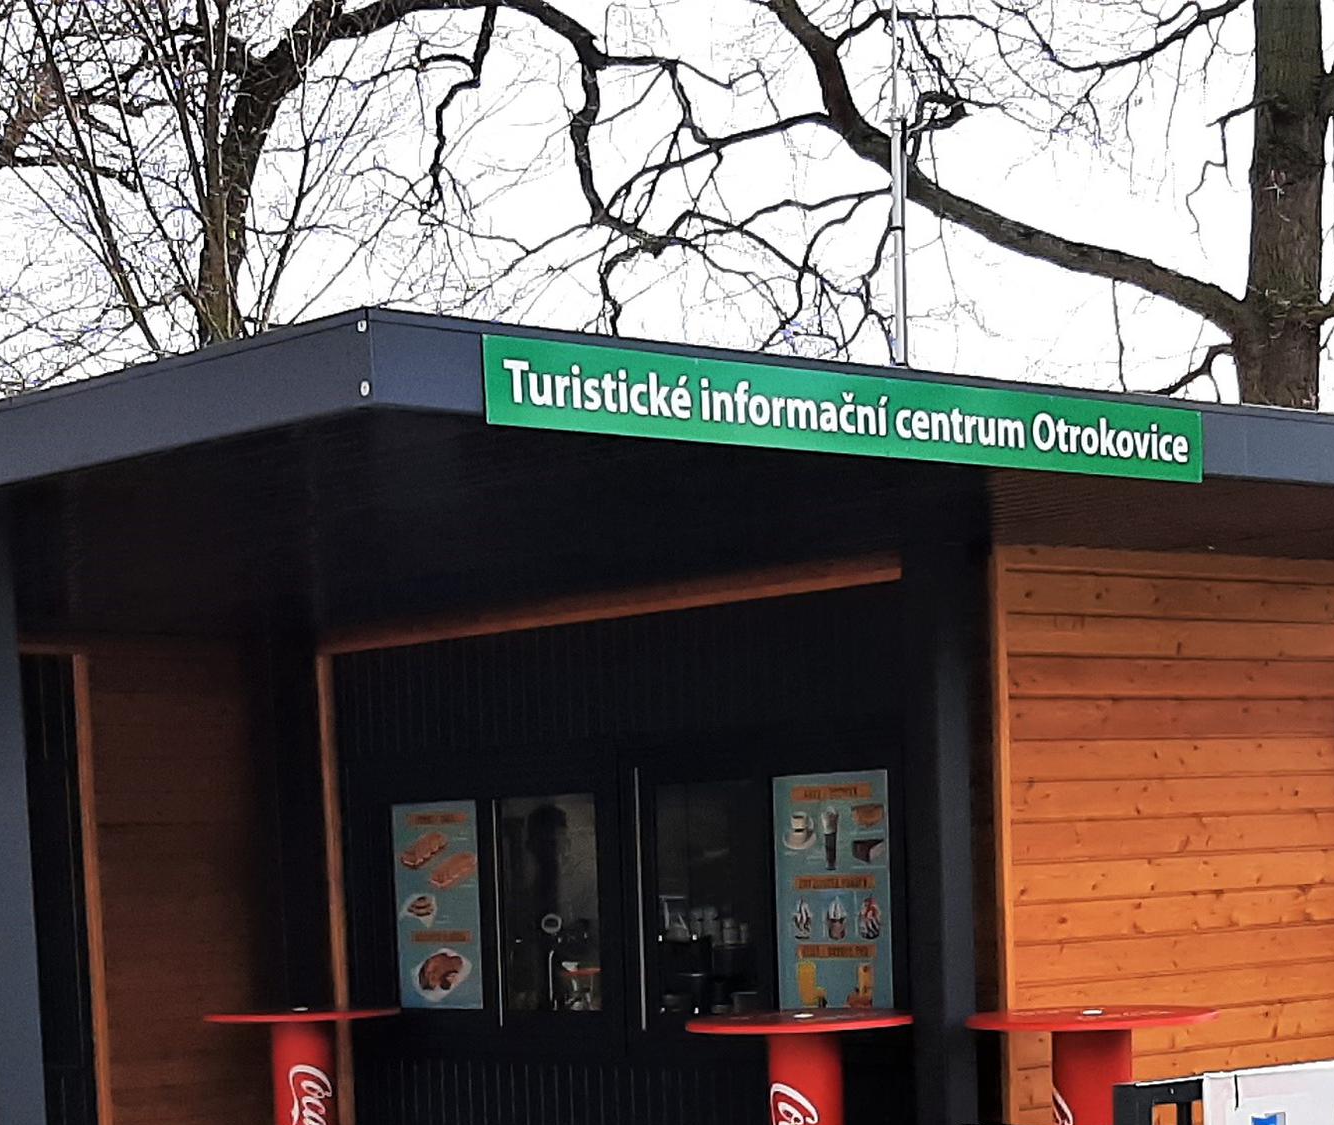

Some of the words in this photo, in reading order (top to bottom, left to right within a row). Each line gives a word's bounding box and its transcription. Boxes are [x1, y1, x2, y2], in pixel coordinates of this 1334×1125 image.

[503, 358, 692, 420] Turistické
[700, 379, 889, 437] informační
[895, 409, 1026, 449] centrum
[1032, 412, 1190, 464] Otrokovice
